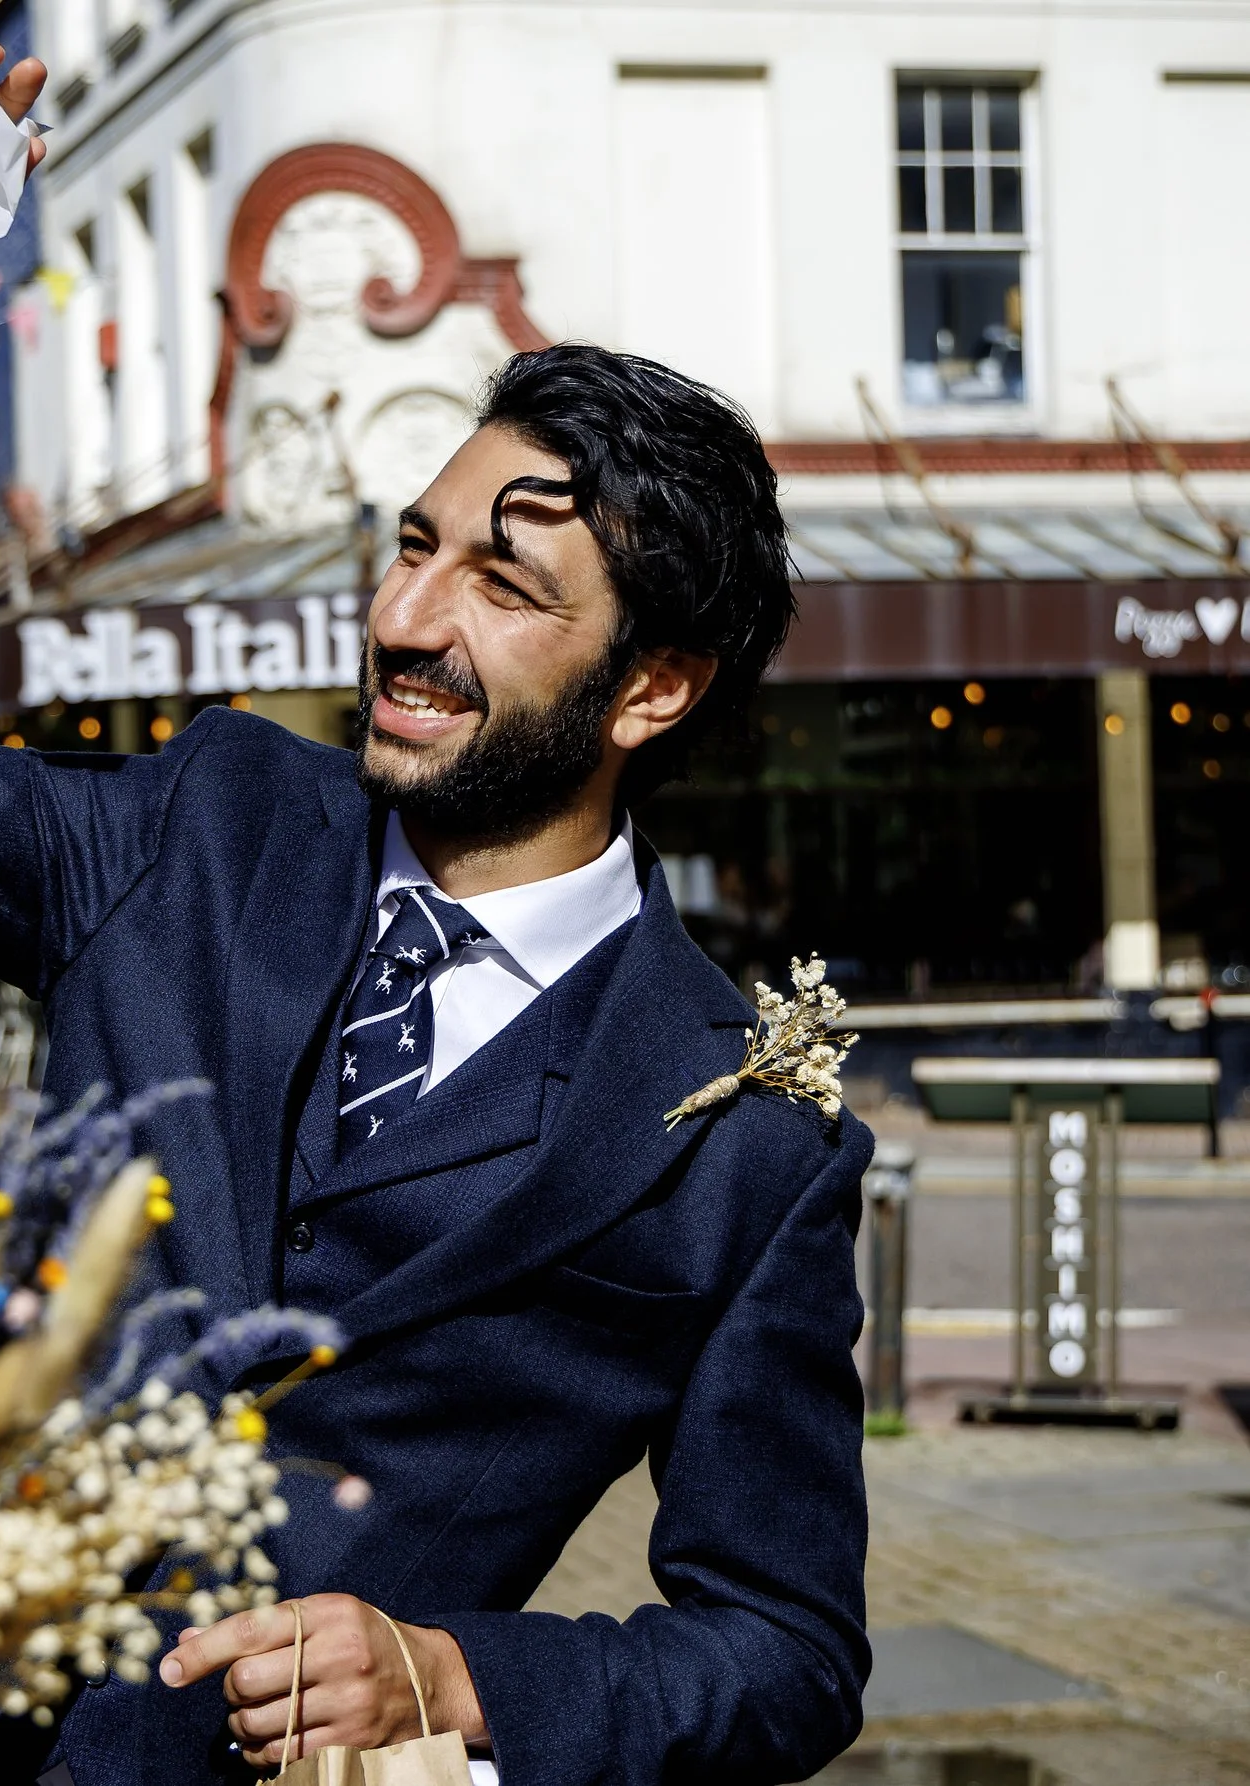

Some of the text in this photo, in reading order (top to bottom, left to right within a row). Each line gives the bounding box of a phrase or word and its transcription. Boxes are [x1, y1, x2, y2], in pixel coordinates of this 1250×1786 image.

[17, 608, 182, 704] Bella
[184, 595, 367, 695] Itali
[1048, 1111, 1087, 1378] MOSHIMO
